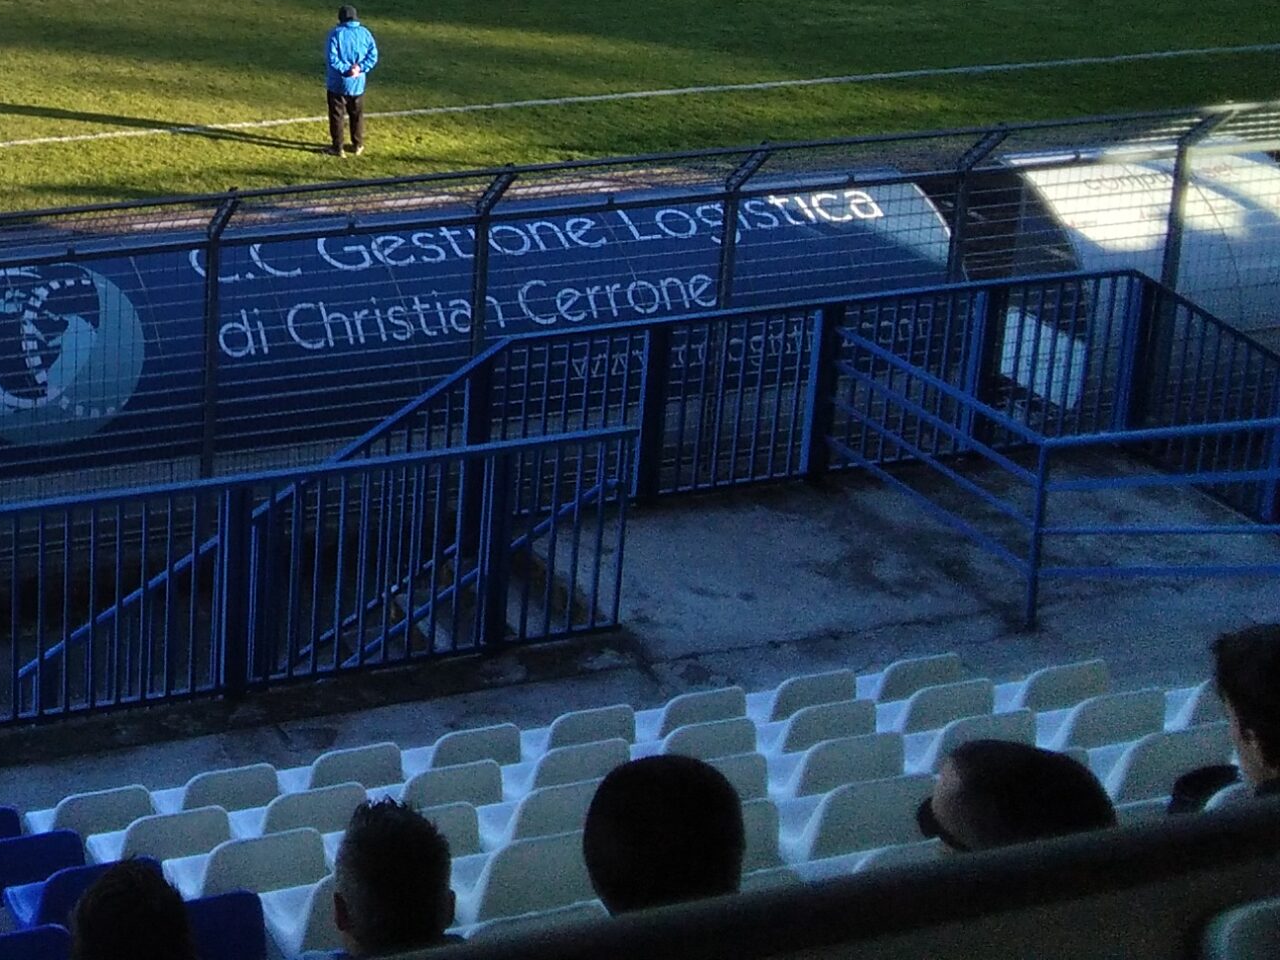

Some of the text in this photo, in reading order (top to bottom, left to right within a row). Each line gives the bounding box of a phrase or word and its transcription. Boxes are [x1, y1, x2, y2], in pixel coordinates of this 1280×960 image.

[317, 216, 608, 271] Gestione
[617, 190, 884, 246] Logistica
[219, 273, 718, 358] di Christian Cerrone
